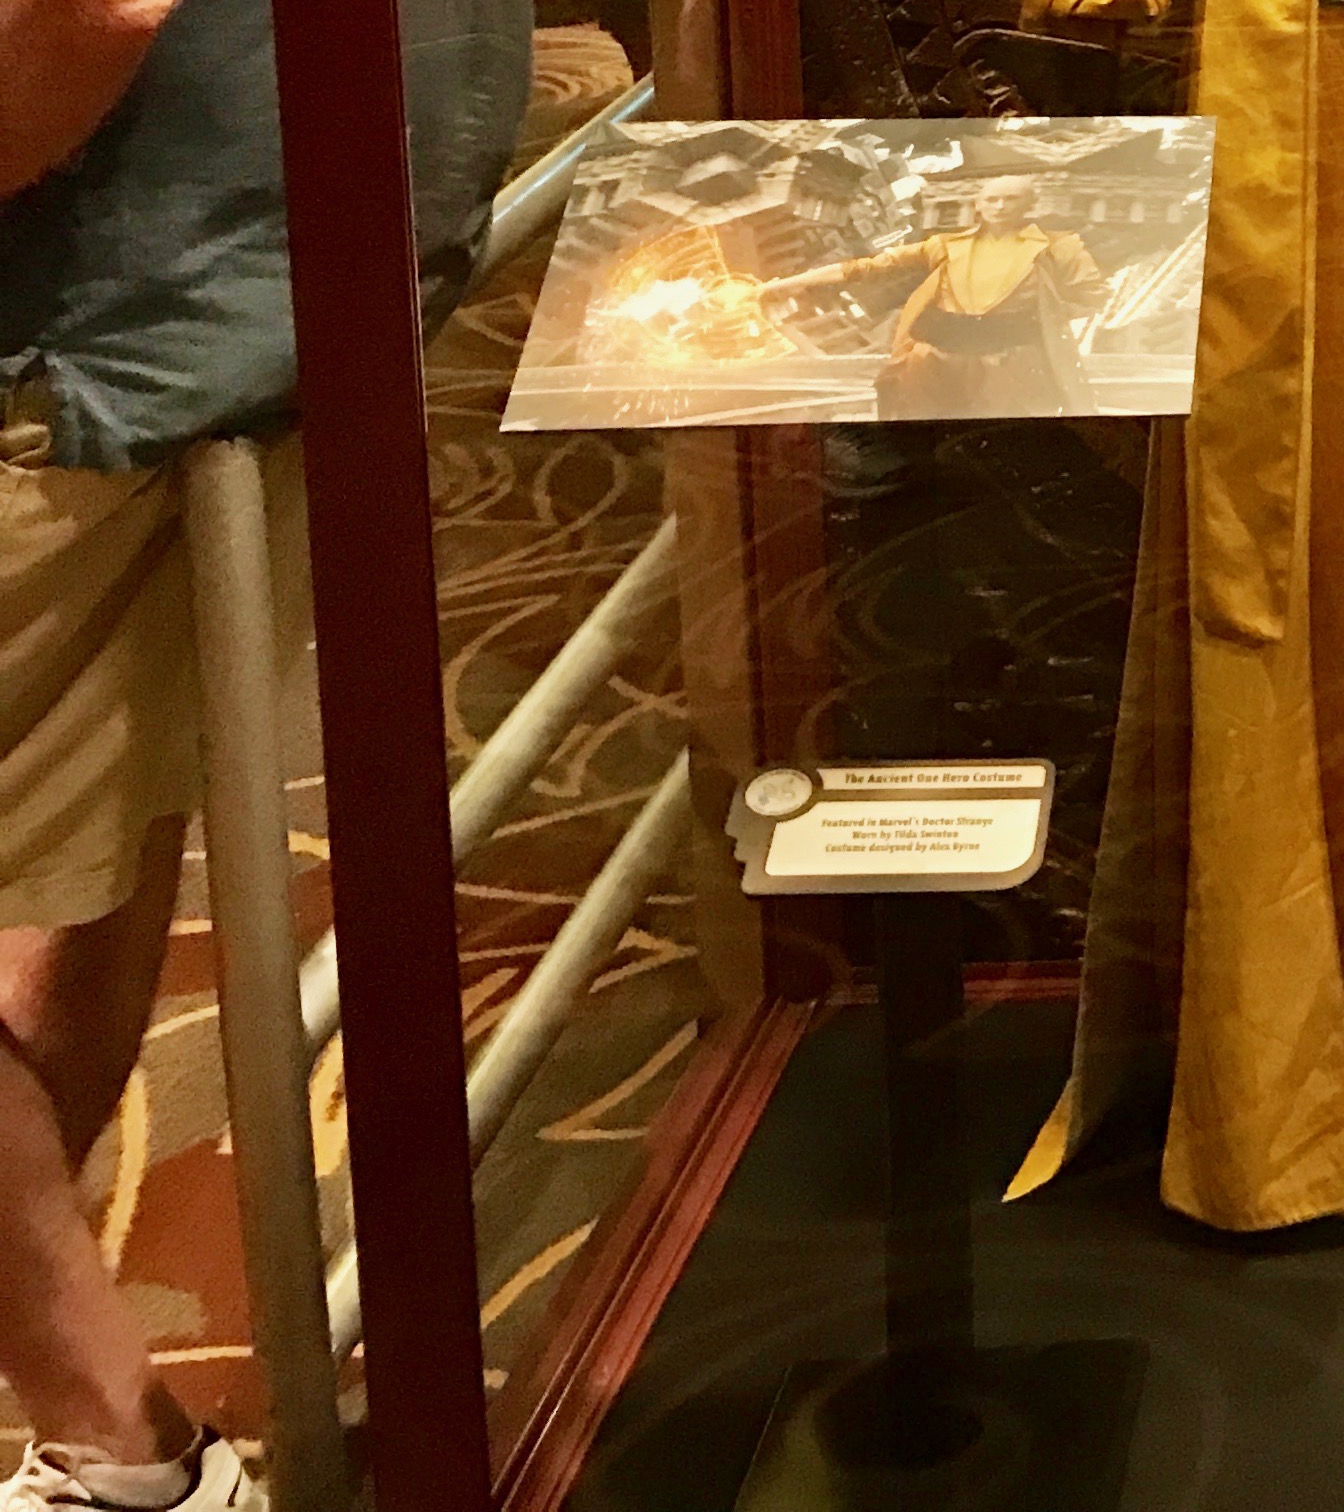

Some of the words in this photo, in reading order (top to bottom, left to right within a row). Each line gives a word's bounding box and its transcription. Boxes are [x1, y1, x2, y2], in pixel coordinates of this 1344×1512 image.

[845, 773, 864, 784] The
[867, 773, 913, 784] Ancient
[917, 773, 939, 783] One
[942, 773, 970, 783] Hero
[973, 772, 1022, 782] Costume
[821, 817, 865, 827] Featured
[867, 818, 876, 826] in
[879, 817, 919, 826] Marvel's
[922, 818, 954, 826] Doctor
[956, 817, 994, 827] Strange
[852, 830, 877, 839] Worn
[880, 830, 891, 840] by
[920, 829, 959, 838] Swinton
[825, 843, 866, 852] Costume
[868, 842, 912, 853] designed
[915, 842, 927, 853] by
